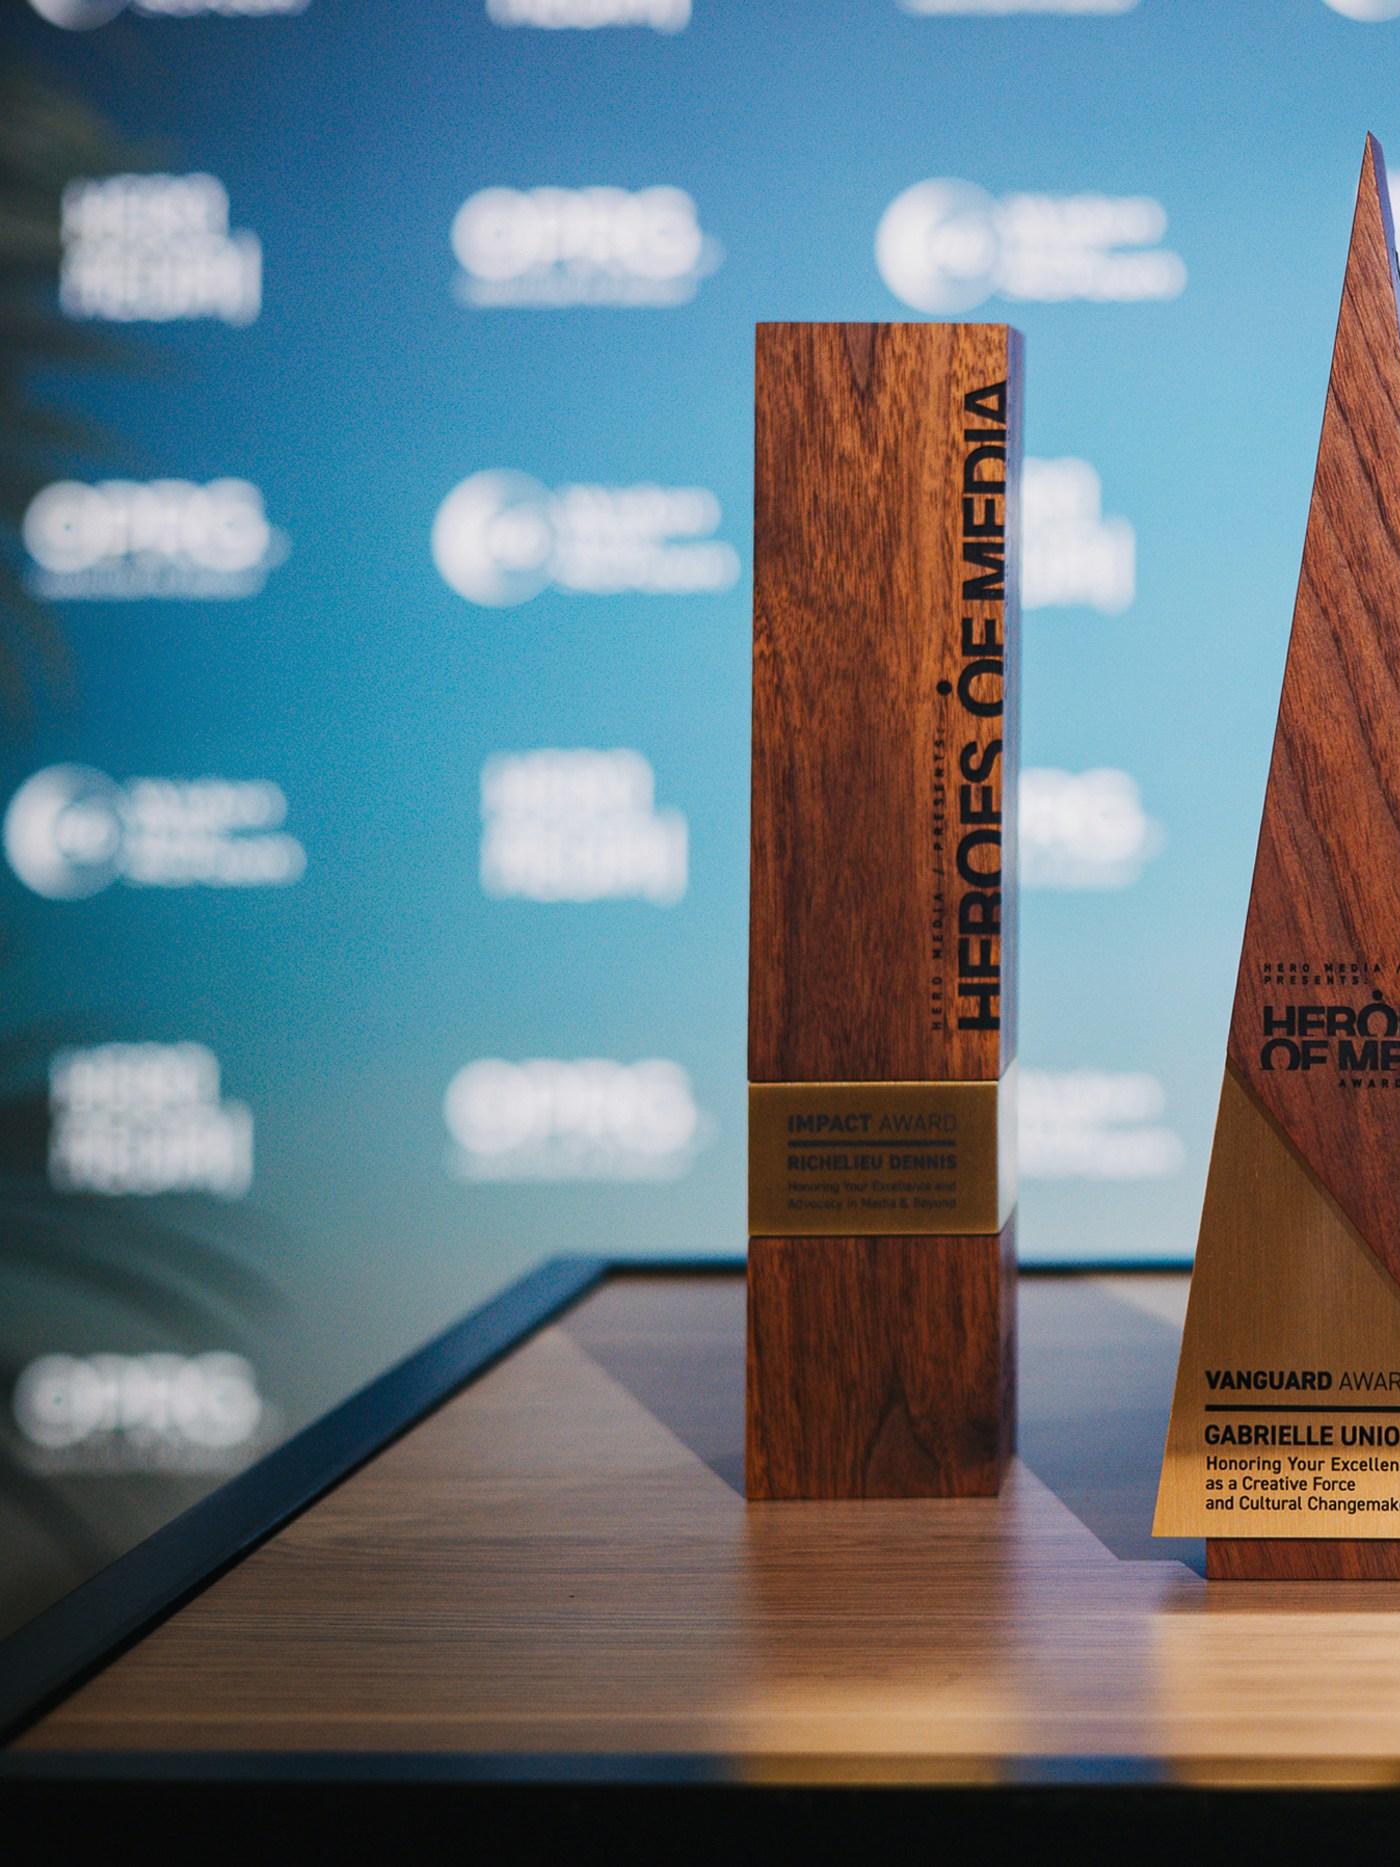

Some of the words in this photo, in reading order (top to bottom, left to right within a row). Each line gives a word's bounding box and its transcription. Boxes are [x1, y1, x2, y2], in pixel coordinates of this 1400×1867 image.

[963, 380, 1007, 600] MEDIA
[957, 617, 1004, 718] OF
[956, 739, 1003, 1031] HEROES
[932, 893, 944, 959] MEDIA
[1264, 963, 1310, 973] HERO
[1325, 963, 1381, 973] MEDIA
[1264, 976, 1369, 985] PRESENTS:
[931, 976, 944, 1031] HERO
[1260, 1038, 1329, 1071] OF
[787, 1114, 872, 1133] IMPACT
[879, 1113, 957, 1133] AWARD
[787, 1154, 883, 1171] RICHELIEU
[890, 1154, 957, 1170] DENNIS
[788, 1181, 840, 1194] Honoring
[844, 1181, 868, 1192] Your
[873, 1180, 932, 1192] Excellence
[936, 1180, 957, 1192] and
[787, 1199, 843, 1211] Advocacy
[1205, 1370, 1333, 1391] VANGUARD
[1204, 1425, 1334, 1446] GABRIELLE
[1206, 1456, 1281, 1474] Honoring
[1287, 1456, 1325, 1471] Your
[1205, 1479, 1223, 1490] as
[1228, 1479, 1237, 1490] a
[1242, 1476, 1308, 1491] Creative
[1313, 1476, 1356, 1491] Force
[1205, 1496, 1234, 1510] and
[1239, 1496, 1302, 1511] Cultural
